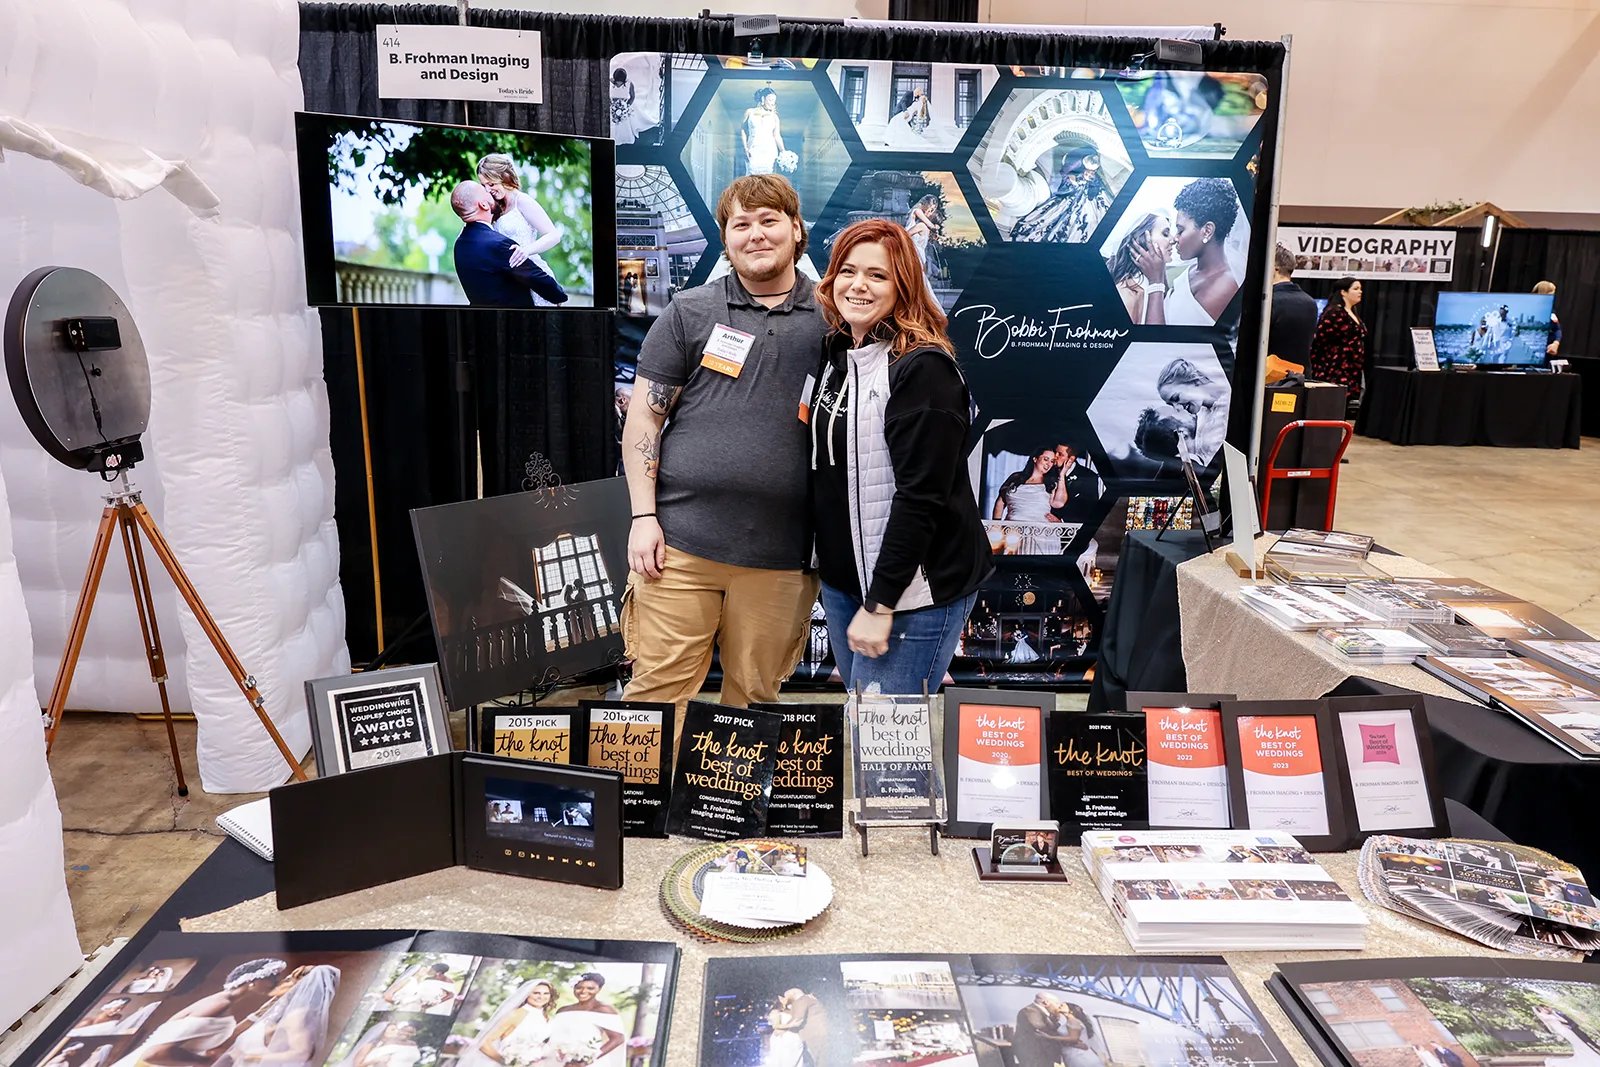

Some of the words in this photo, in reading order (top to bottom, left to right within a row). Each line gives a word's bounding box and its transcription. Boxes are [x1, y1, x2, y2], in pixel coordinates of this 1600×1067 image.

[382, 38, 400, 47] 414
[389, 53, 402, 64] B.
[405, 52, 468, 64] Frohman
[471, 54, 530, 69] Imaging
[420, 69, 446, 80] and
[450, 68, 499, 83] Design
[1298, 236, 1453, 256] VIDEOGRAPHY
[722, 333, 744, 343] Arthur
[954, 304, 1048, 359] Bobbi
[1048, 304, 1129, 350] Frohman
[350, 699, 410, 714] WEDDINGWIRE
[386, 708, 412, 716] CHOICE
[508, 718, 532, 727] 2015
[629, 714, 650, 722] PICK
[713, 714, 732, 725] 2017
[734, 717, 754, 727] PICK
[860, 706, 887, 726] the
[891, 704, 927, 725] knot
[976, 714, 996, 727] the
[998, 716, 1025, 730] knot
[354, 716, 414, 736] Awards
[1158, 717, 1179, 731] the
[1181, 719, 1208, 732] knot
[1253, 724, 1274, 739] the
[1276, 726, 1301, 740] knot
[496, 731, 525, 752] the
[531, 728, 568, 752] knot
[590, 723, 618, 745] the
[622, 722, 660, 747] knot
[872, 726, 901, 740] best
[904, 726, 920, 740] of
[691, 731, 722, 754] the
[726, 732, 768, 762] knot
[793, 729, 834, 755] knot
[976, 738, 1024, 748] WEDDINGS
[1160, 742, 1209, 750] WEDDINGS
[376, 748, 400, 759] 2016
[601, 746, 632, 762] best
[634, 746, 651, 762] of
[860, 741, 931, 760] weddings
[1054, 738, 1092, 764] the
[1096, 742, 1144, 766] knot
[701, 753, 733, 773] best
[736, 760, 754, 777] of
[806, 754, 824, 770] of
[685, 771, 762, 800] weddings
[773, 771, 834, 793] eddings
[699, 795, 742, 806] CONGRATULATIONS!
[691, 809, 713, 818] Imaging
[726, 814, 745, 823] Design
[710, 805, 735, 814] Frohman
